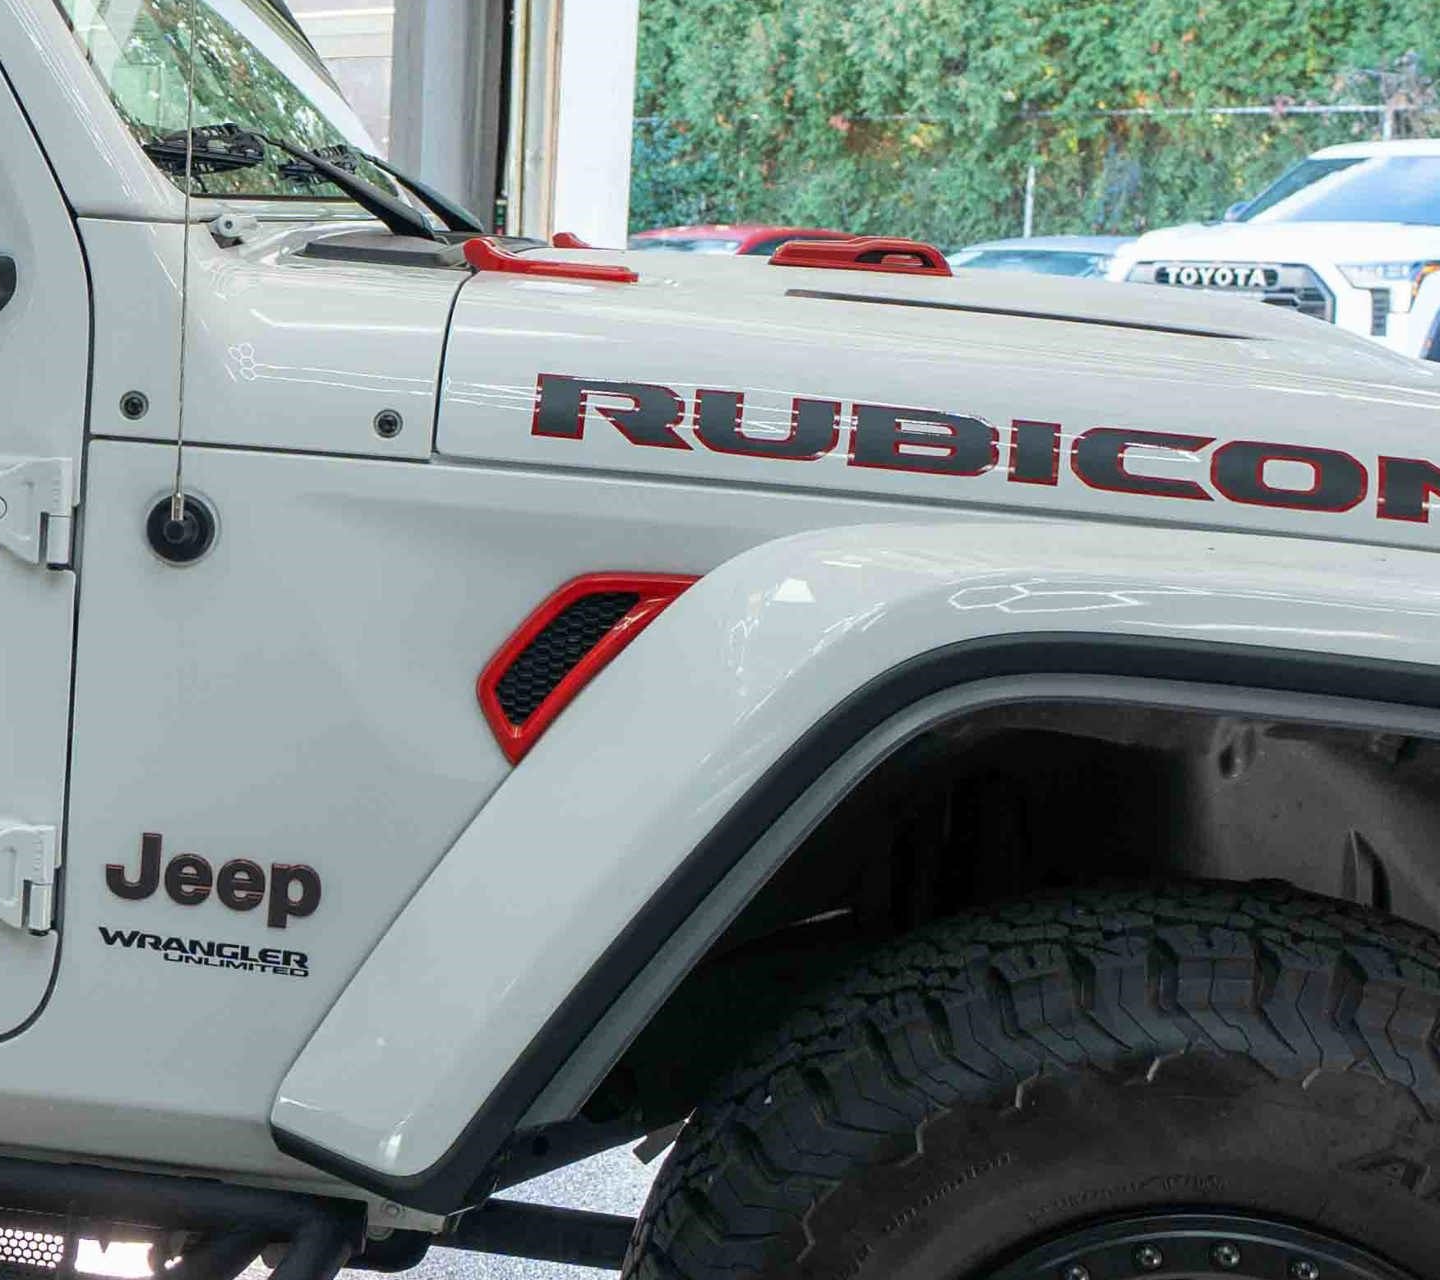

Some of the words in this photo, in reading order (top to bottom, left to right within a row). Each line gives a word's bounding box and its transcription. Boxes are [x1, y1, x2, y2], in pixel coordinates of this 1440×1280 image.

[1165, 267, 1267, 287] TOYOTA
[105, 831, 322, 929] Jeep
[98, 926, 310, 969] WRANGLER
[162, 951, 310, 978] UNLIMITED
